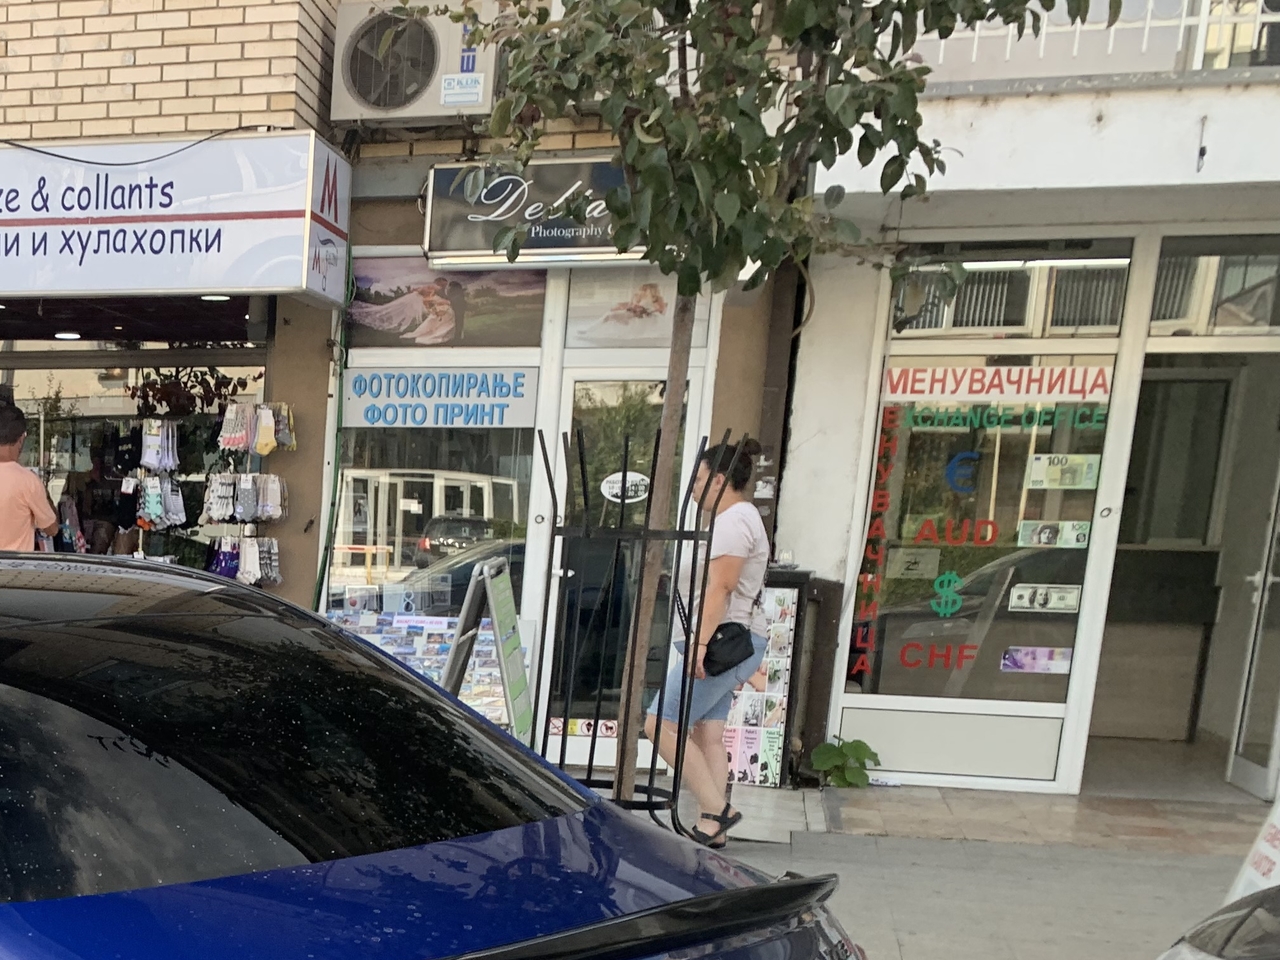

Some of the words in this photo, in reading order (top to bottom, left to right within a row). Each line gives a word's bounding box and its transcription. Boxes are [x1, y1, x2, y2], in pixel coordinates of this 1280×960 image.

[31, 176, 50, 213] &
[61, 173, 175, 212] collants
[530, 223, 605, 239] Photography
[32, 232, 48, 256] и
[59, 227, 222, 266] хулахопки
[352, 372, 526, 399] ФОТОКОПИРАЊЕ
[886, 367, 1110, 399] МЕНУВАЧНИЦА
[363, 404, 428, 426] ФОТО
[433, 403, 510, 426] ПРИНТ
[1021, 406, 1108, 430] OFFICE
[1046, 455, 1068, 466] 100
[914, 519, 999, 547] AUD
[899, 642, 978, 671] CHF
